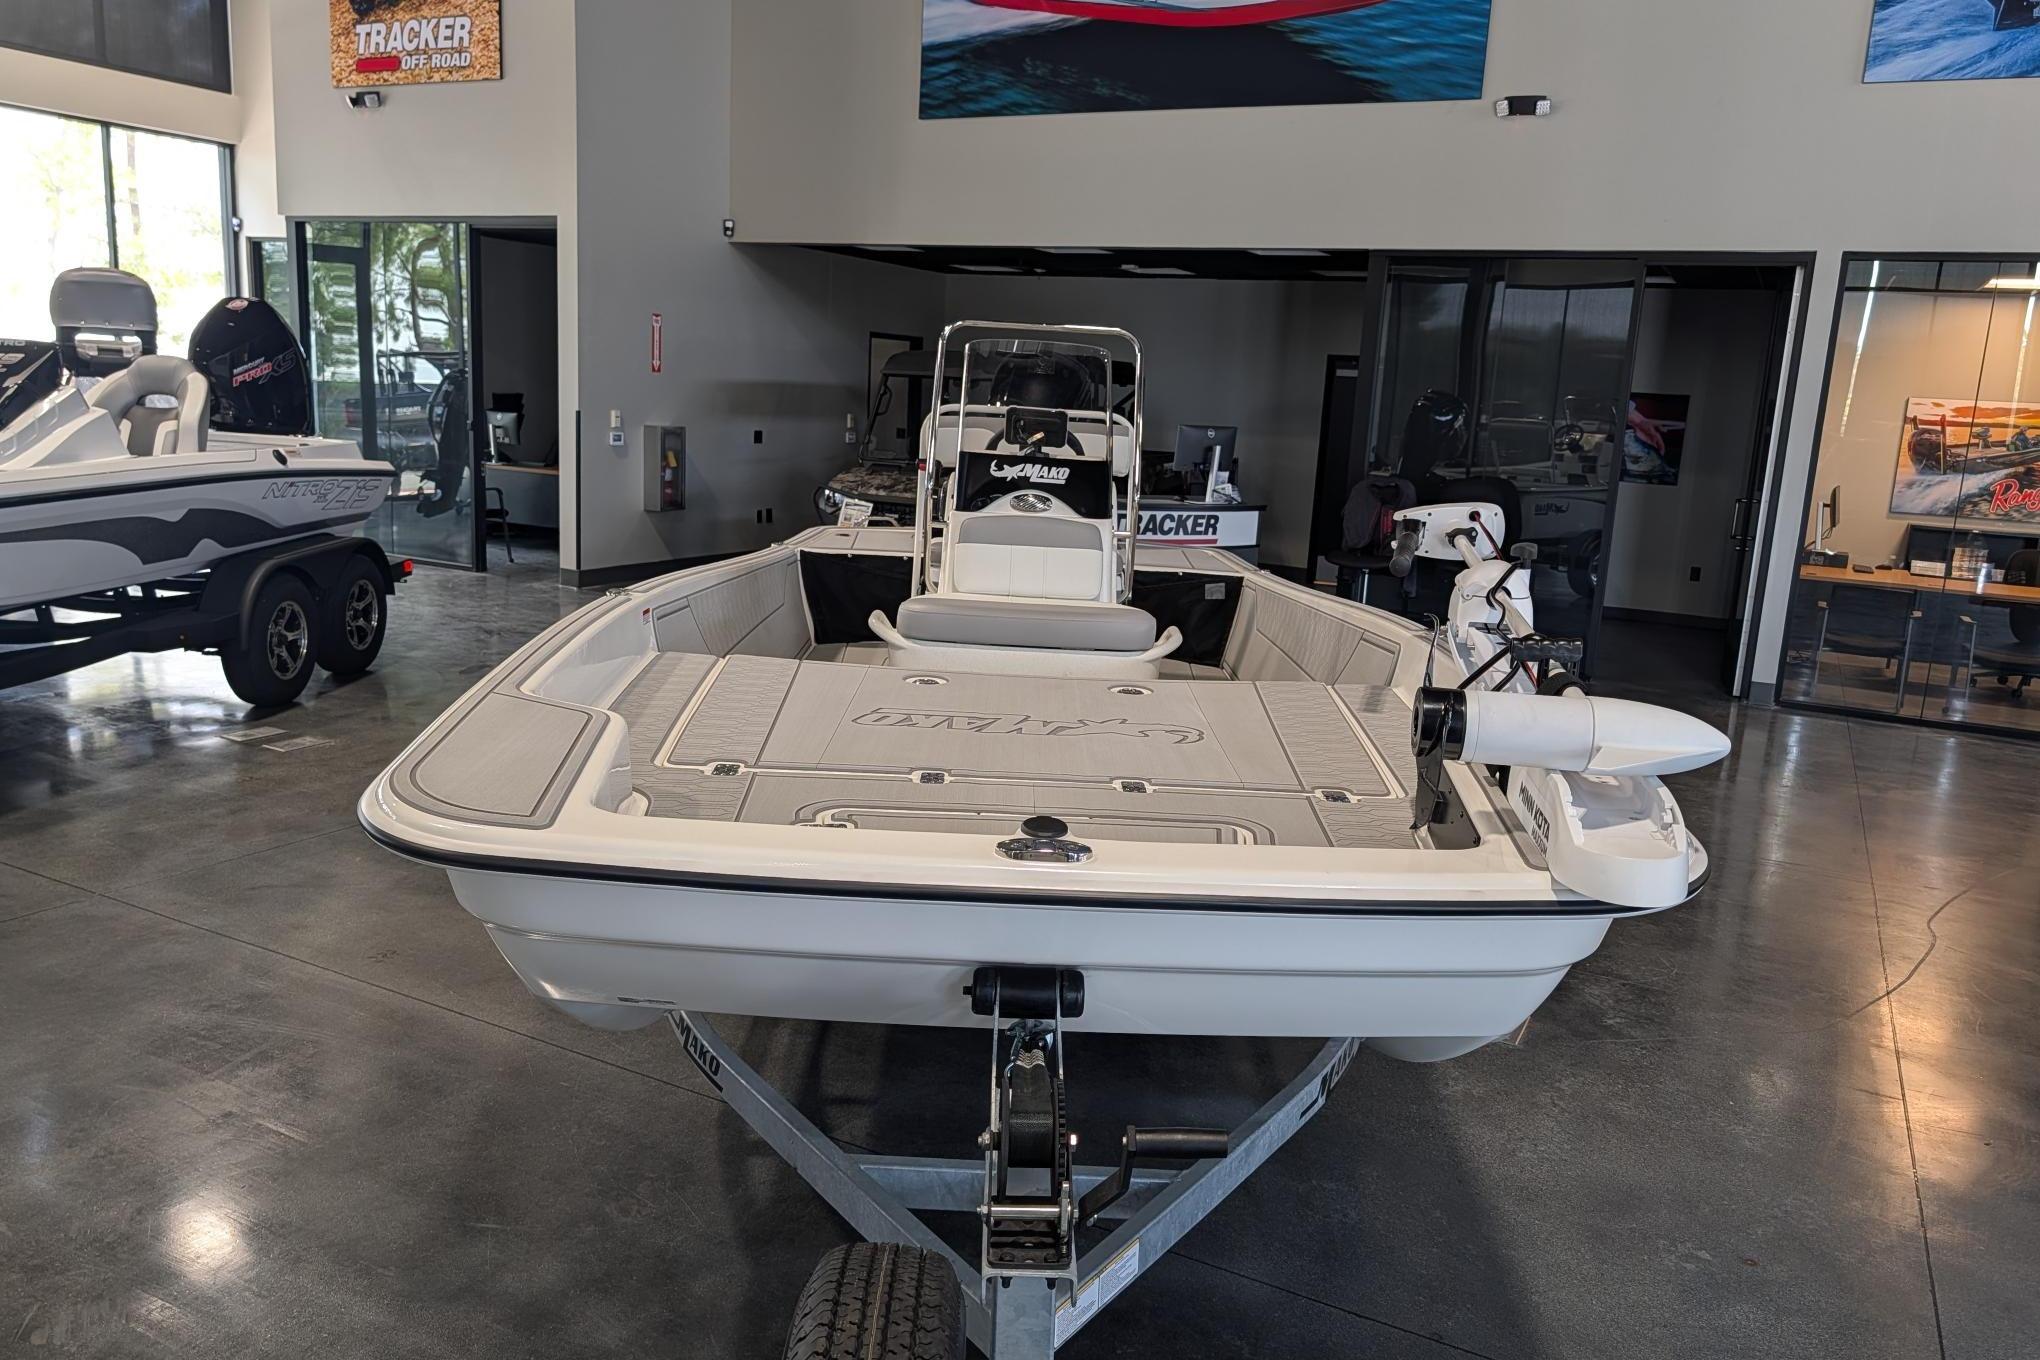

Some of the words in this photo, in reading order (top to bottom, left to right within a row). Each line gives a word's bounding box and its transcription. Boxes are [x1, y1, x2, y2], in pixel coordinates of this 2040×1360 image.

[356, 16, 472, 54] TRACKER
[401, 54, 428, 70] OFF
[431, 52, 471, 68] ROAD
[233, 356, 265, 376] MERCURY
[1016, 463, 1070, 485] MAKO
[261, 479, 339, 500] NITRO
[851, 707, 1058, 736] MAKO
[1519, 780, 1536, 818] MINN
[1533, 803, 1551, 843] KOTA
[664, 1010, 724, 1094] MAKO
